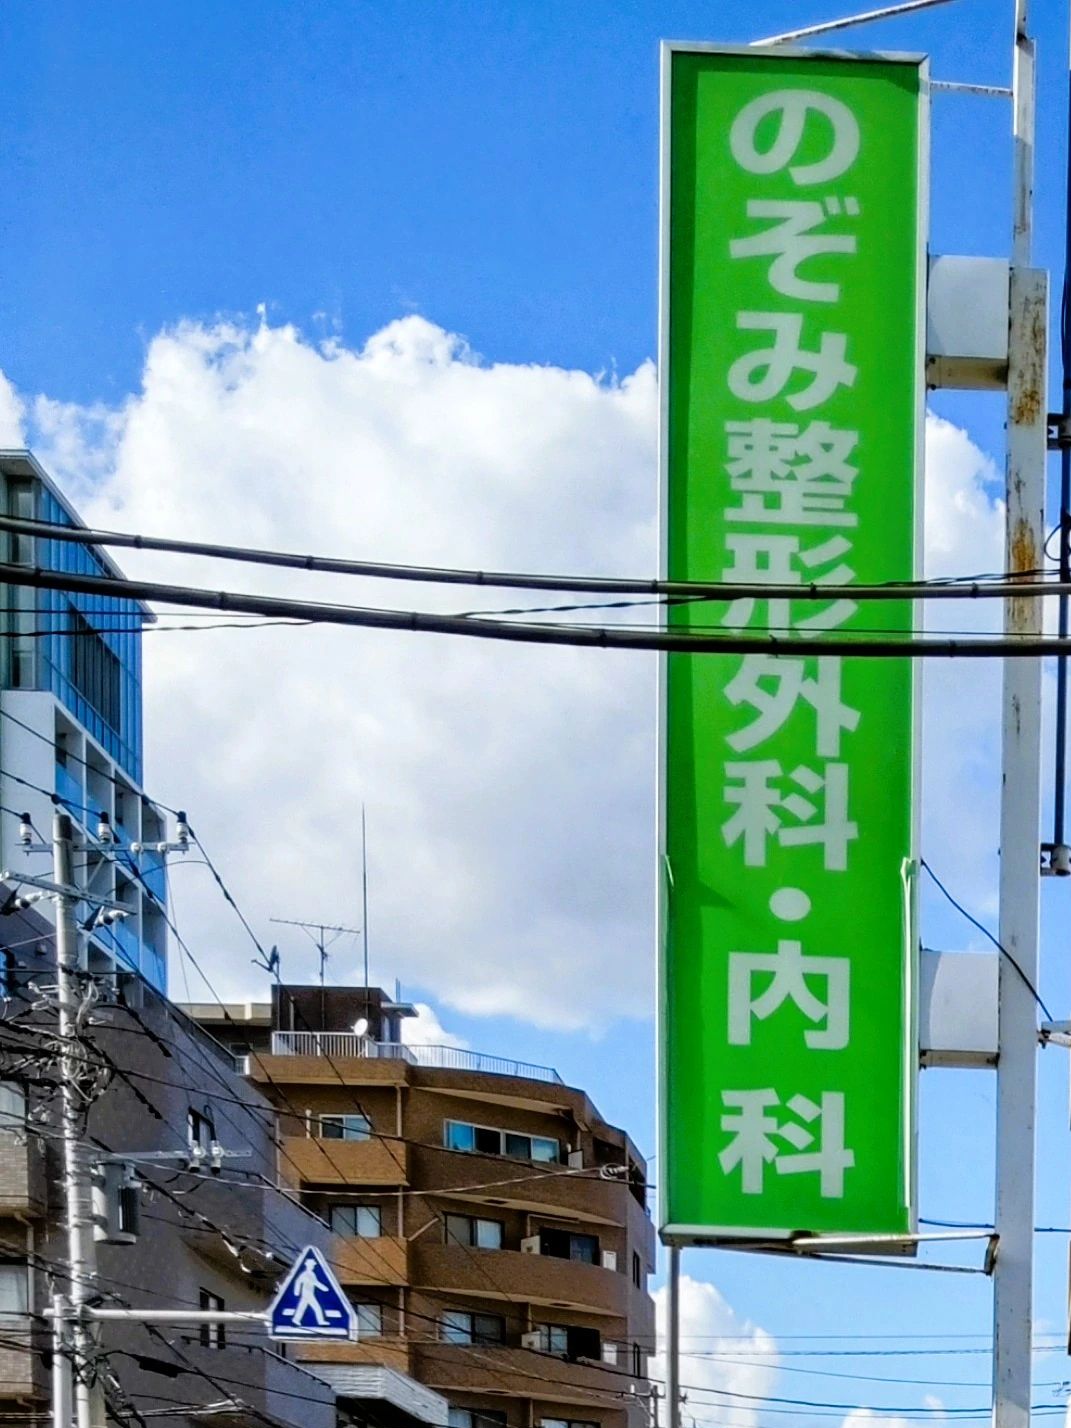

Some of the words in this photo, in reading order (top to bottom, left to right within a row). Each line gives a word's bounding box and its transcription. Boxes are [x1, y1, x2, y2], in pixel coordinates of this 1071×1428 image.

[718, 88, 862, 1199] のぞみ整形外科・内科
